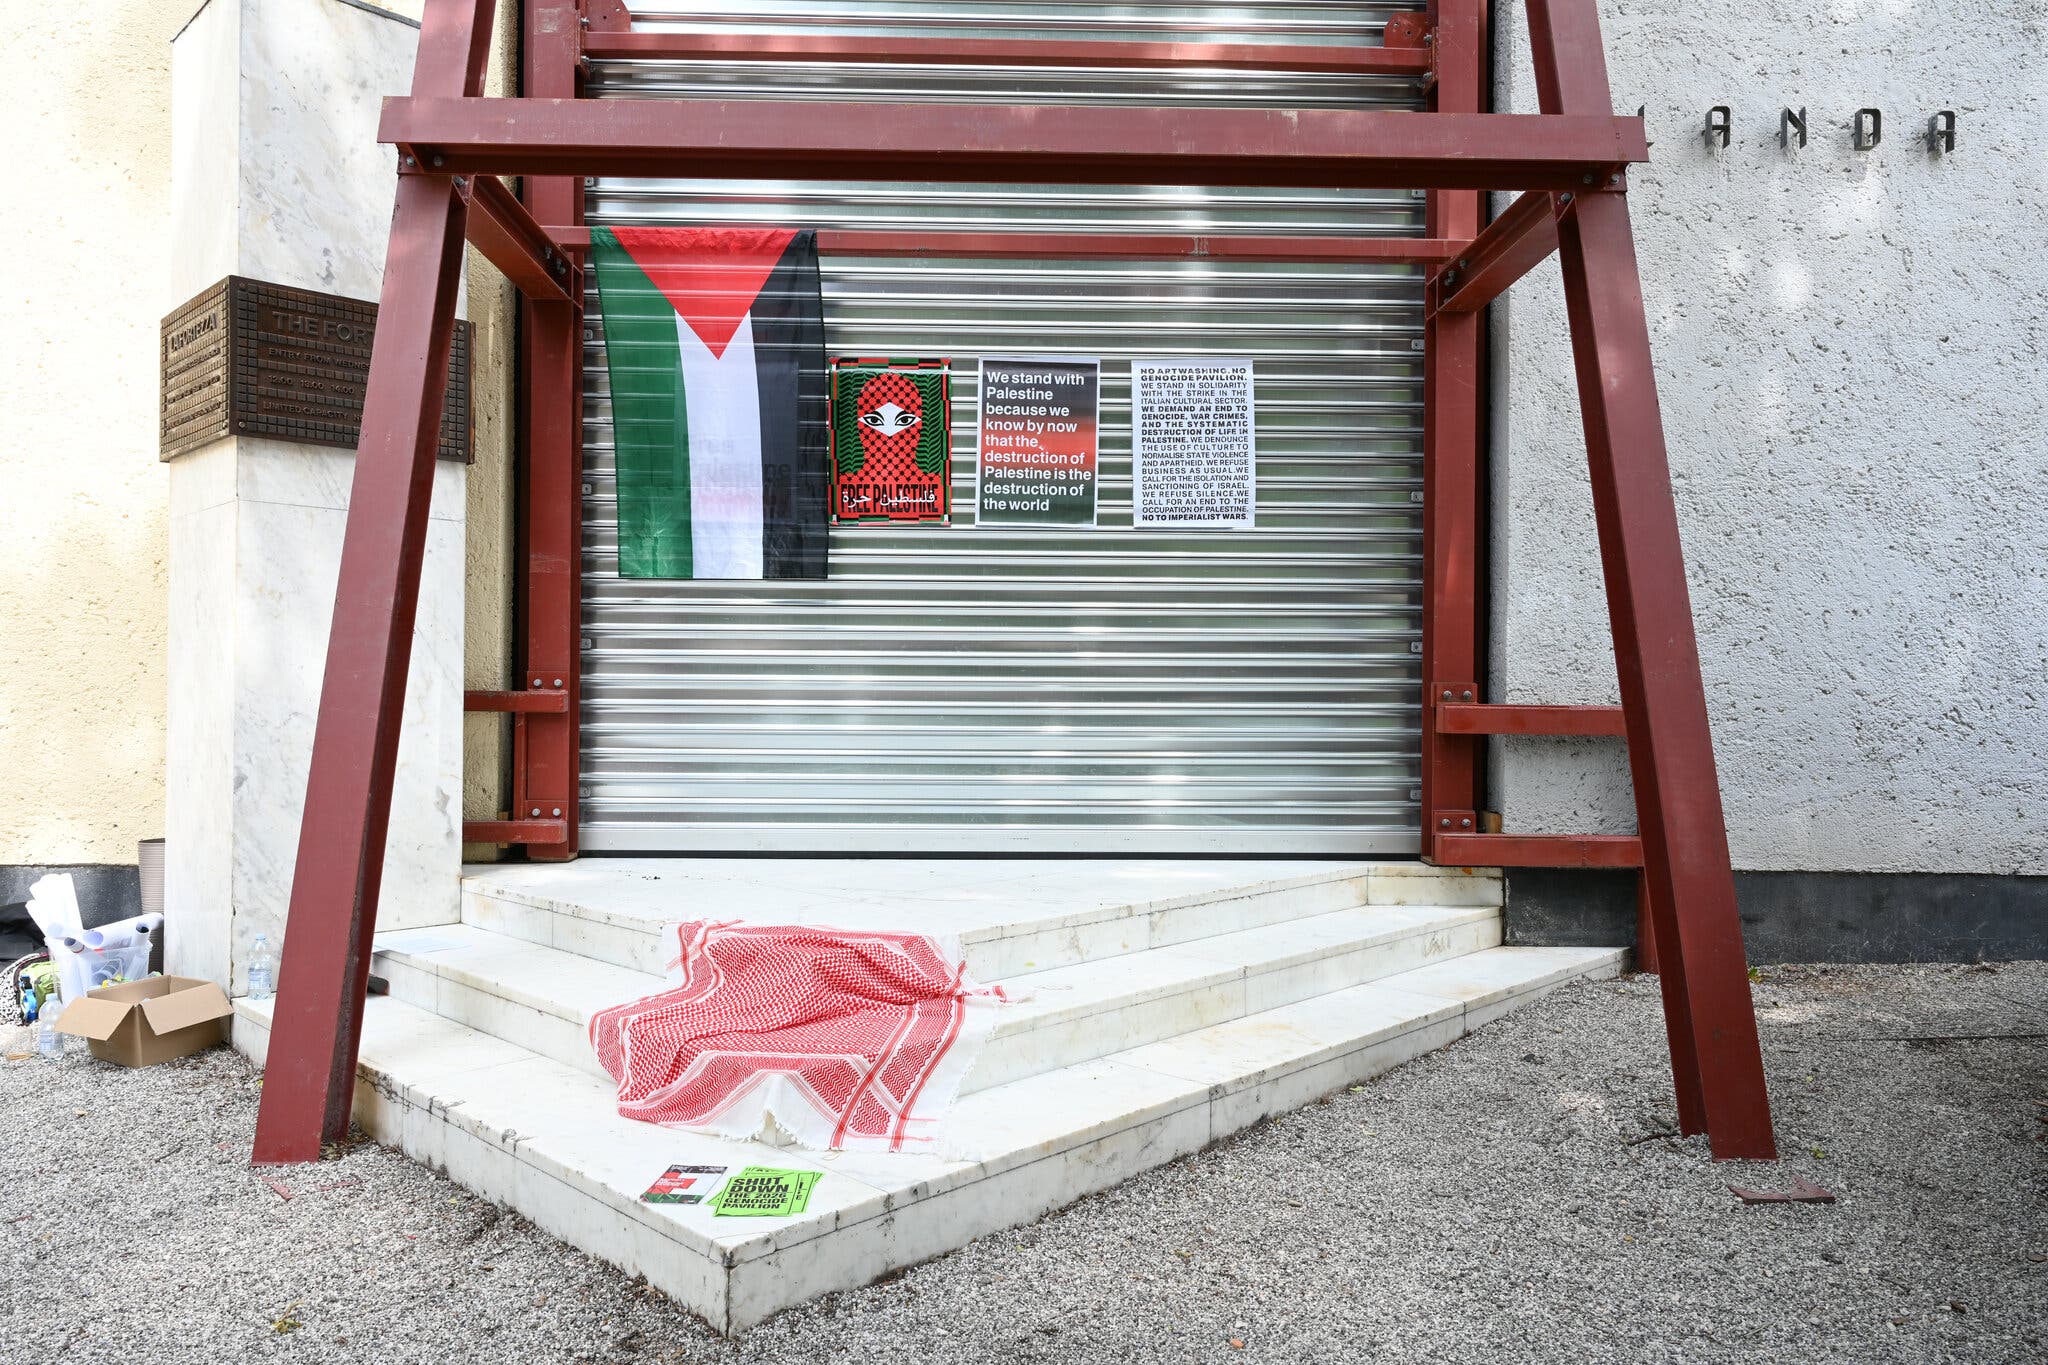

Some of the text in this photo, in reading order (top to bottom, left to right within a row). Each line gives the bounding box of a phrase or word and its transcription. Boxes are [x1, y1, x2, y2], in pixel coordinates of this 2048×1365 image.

[1638, 105, 1956, 153] ANDA
[272, 311, 319, 336] THE
[269, 347, 300, 361] ENTRY
[304, 352, 331, 366] FROM
[300, 380, 324, 390] 13.00
[987, 371, 1084, 385] We stand with
[987, 387, 1053, 400] Palestine
[263, 401, 300, 413] LIMITED
[303, 406, 348, 421] CAPACITY
[986, 403, 1069, 416] because we
[986, 419, 1077, 434] know by now
[985, 435, 1038, 447] that the
[985, 450, 1085, 464] destruction of
[1142, 459, 1248, 467] AND APARTHEID. WE REFUSE
[985, 466, 1091, 480] Palestine is the
[984, 482, 1084, 496] destruction of
[841, 484, 938, 513] FREE PALESTINE
[842, 490, 935, 508] فلسطين حرة
[984, 498, 1050, 511] the world
[730, 1184, 789, 1193] DOWN
[733, 1177, 785, 1186] SHUT
